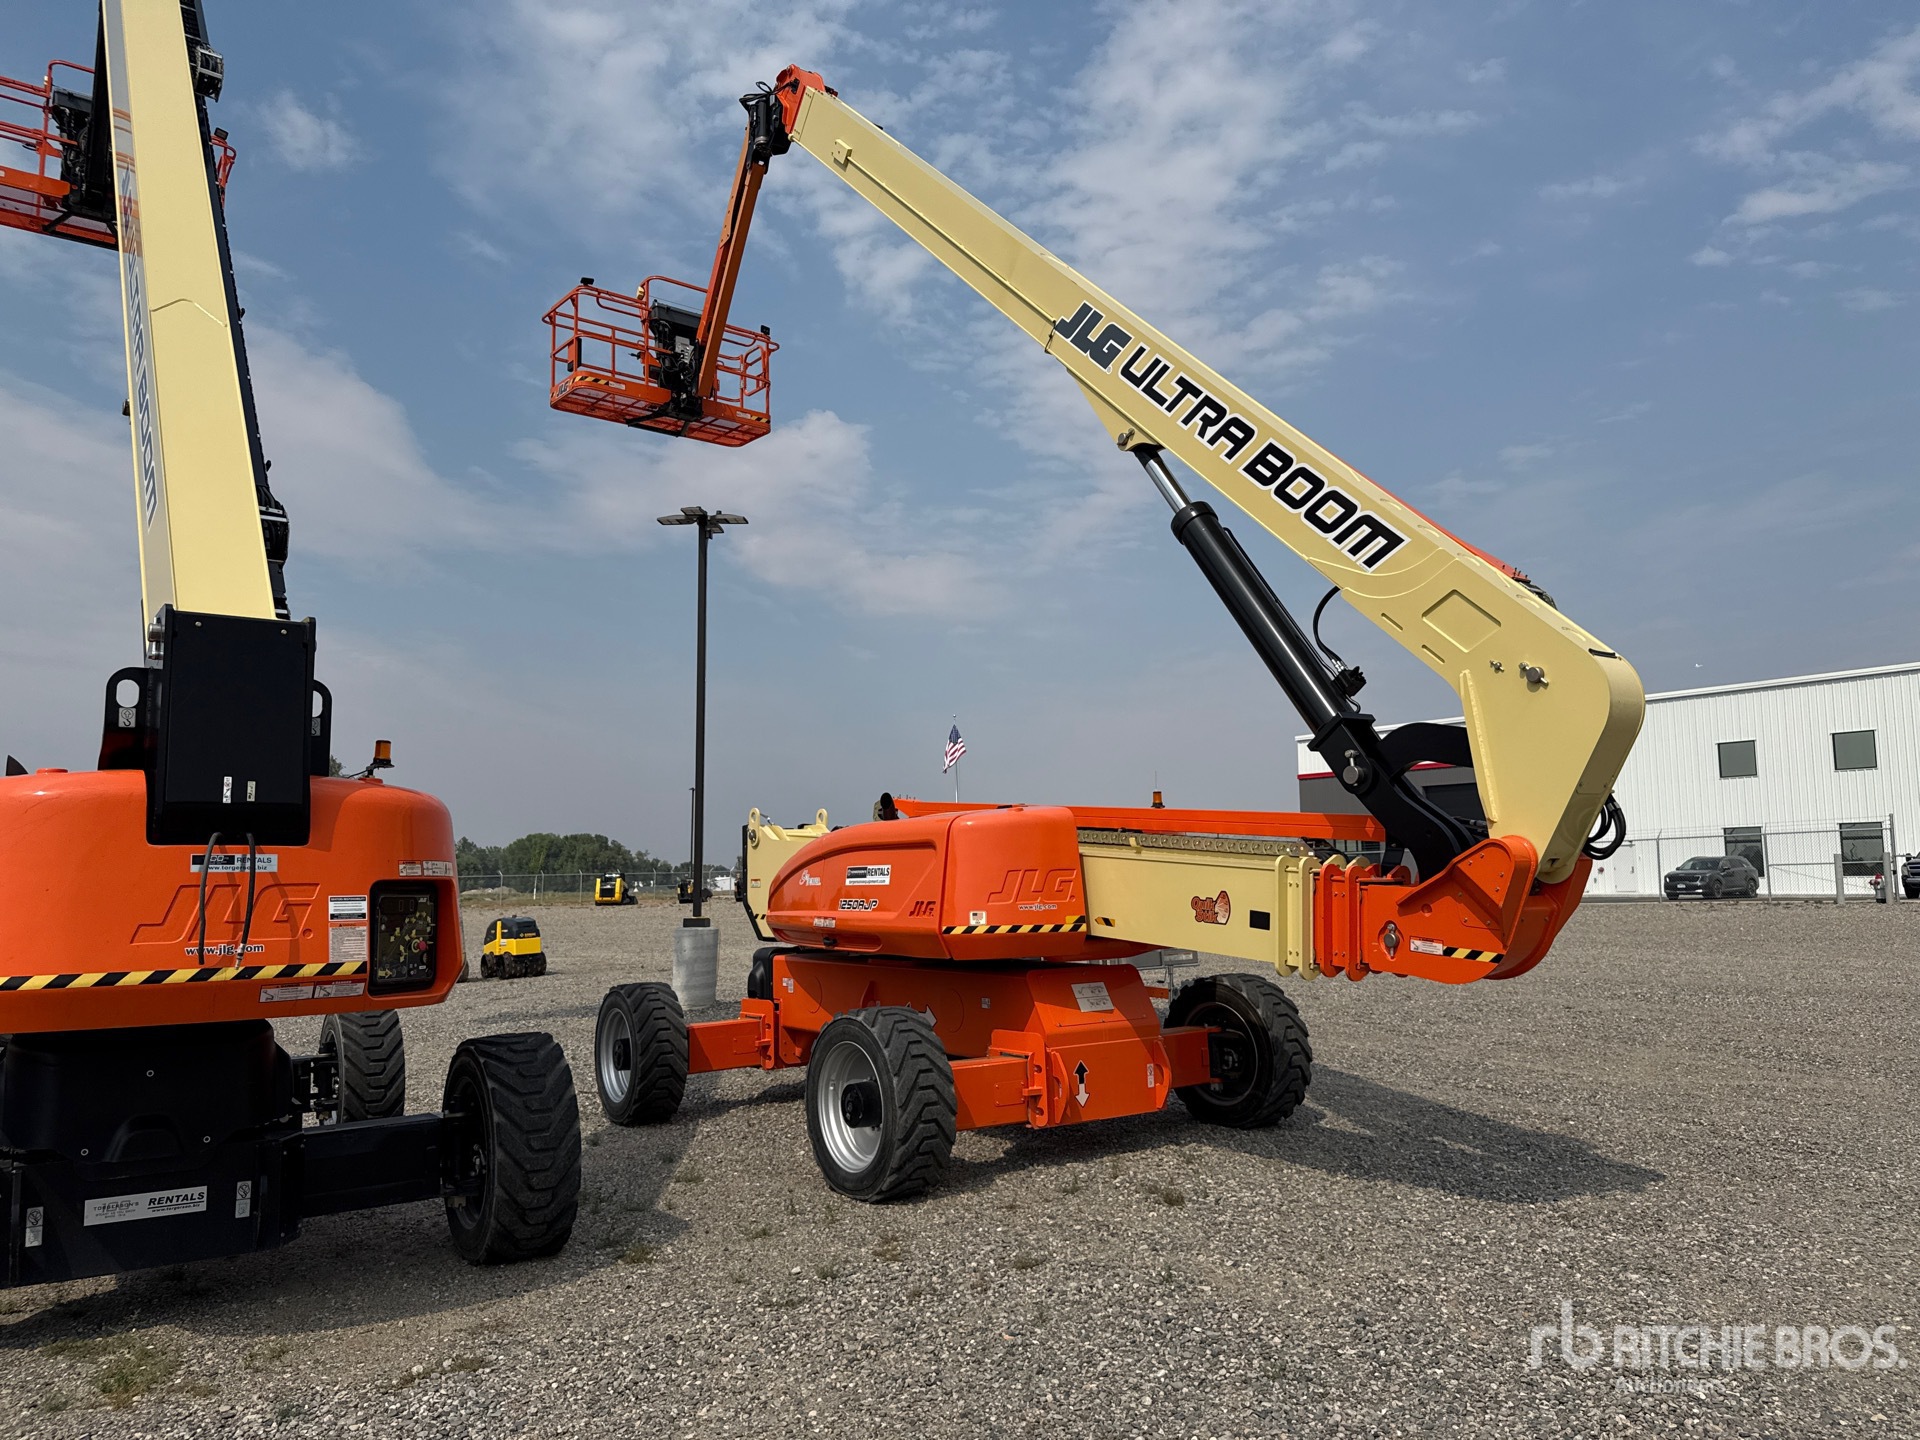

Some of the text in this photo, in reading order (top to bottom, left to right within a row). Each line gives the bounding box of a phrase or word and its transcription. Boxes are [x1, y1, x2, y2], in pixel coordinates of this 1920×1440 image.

[128, 226, 145, 379] ULTRA
[137, 365, 158, 529] BOOM
[1054, 300, 1407, 571] JLG ULTRA BOOM
[867, 867, 890, 877] RENTALS
[987, 869, 1077, 904] JLG
[838, 899, 879, 911] 1250AJP
[908, 900, 936, 917] JLG
[1018, 903, 1057, 911] www.jlg.com
[130, 883, 321, 945] JLG
[185, 944, 265, 956] ww.jlg.om
[148, 1192, 205, 1206] RENTALS
